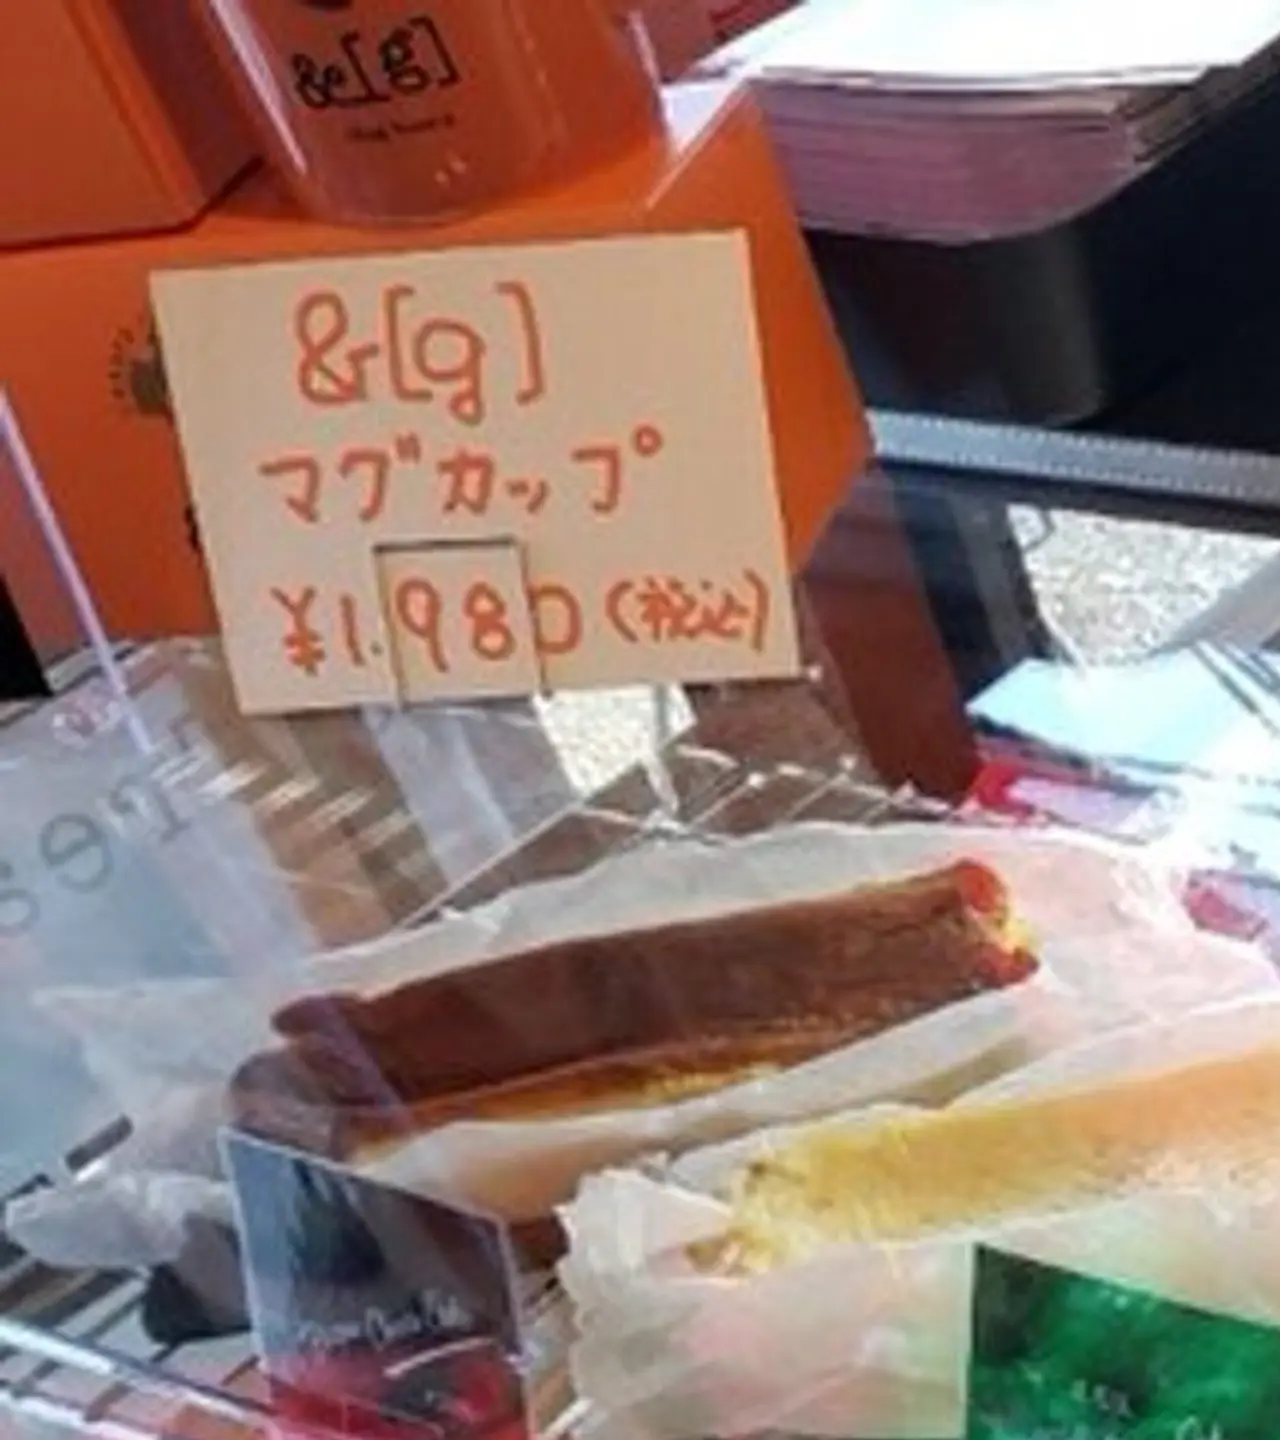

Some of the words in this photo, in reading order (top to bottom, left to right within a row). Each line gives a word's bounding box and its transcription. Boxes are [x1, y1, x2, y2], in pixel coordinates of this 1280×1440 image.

[295, 280, 546, 424] &[g]
[259, 425, 664, 523] マグカップ
